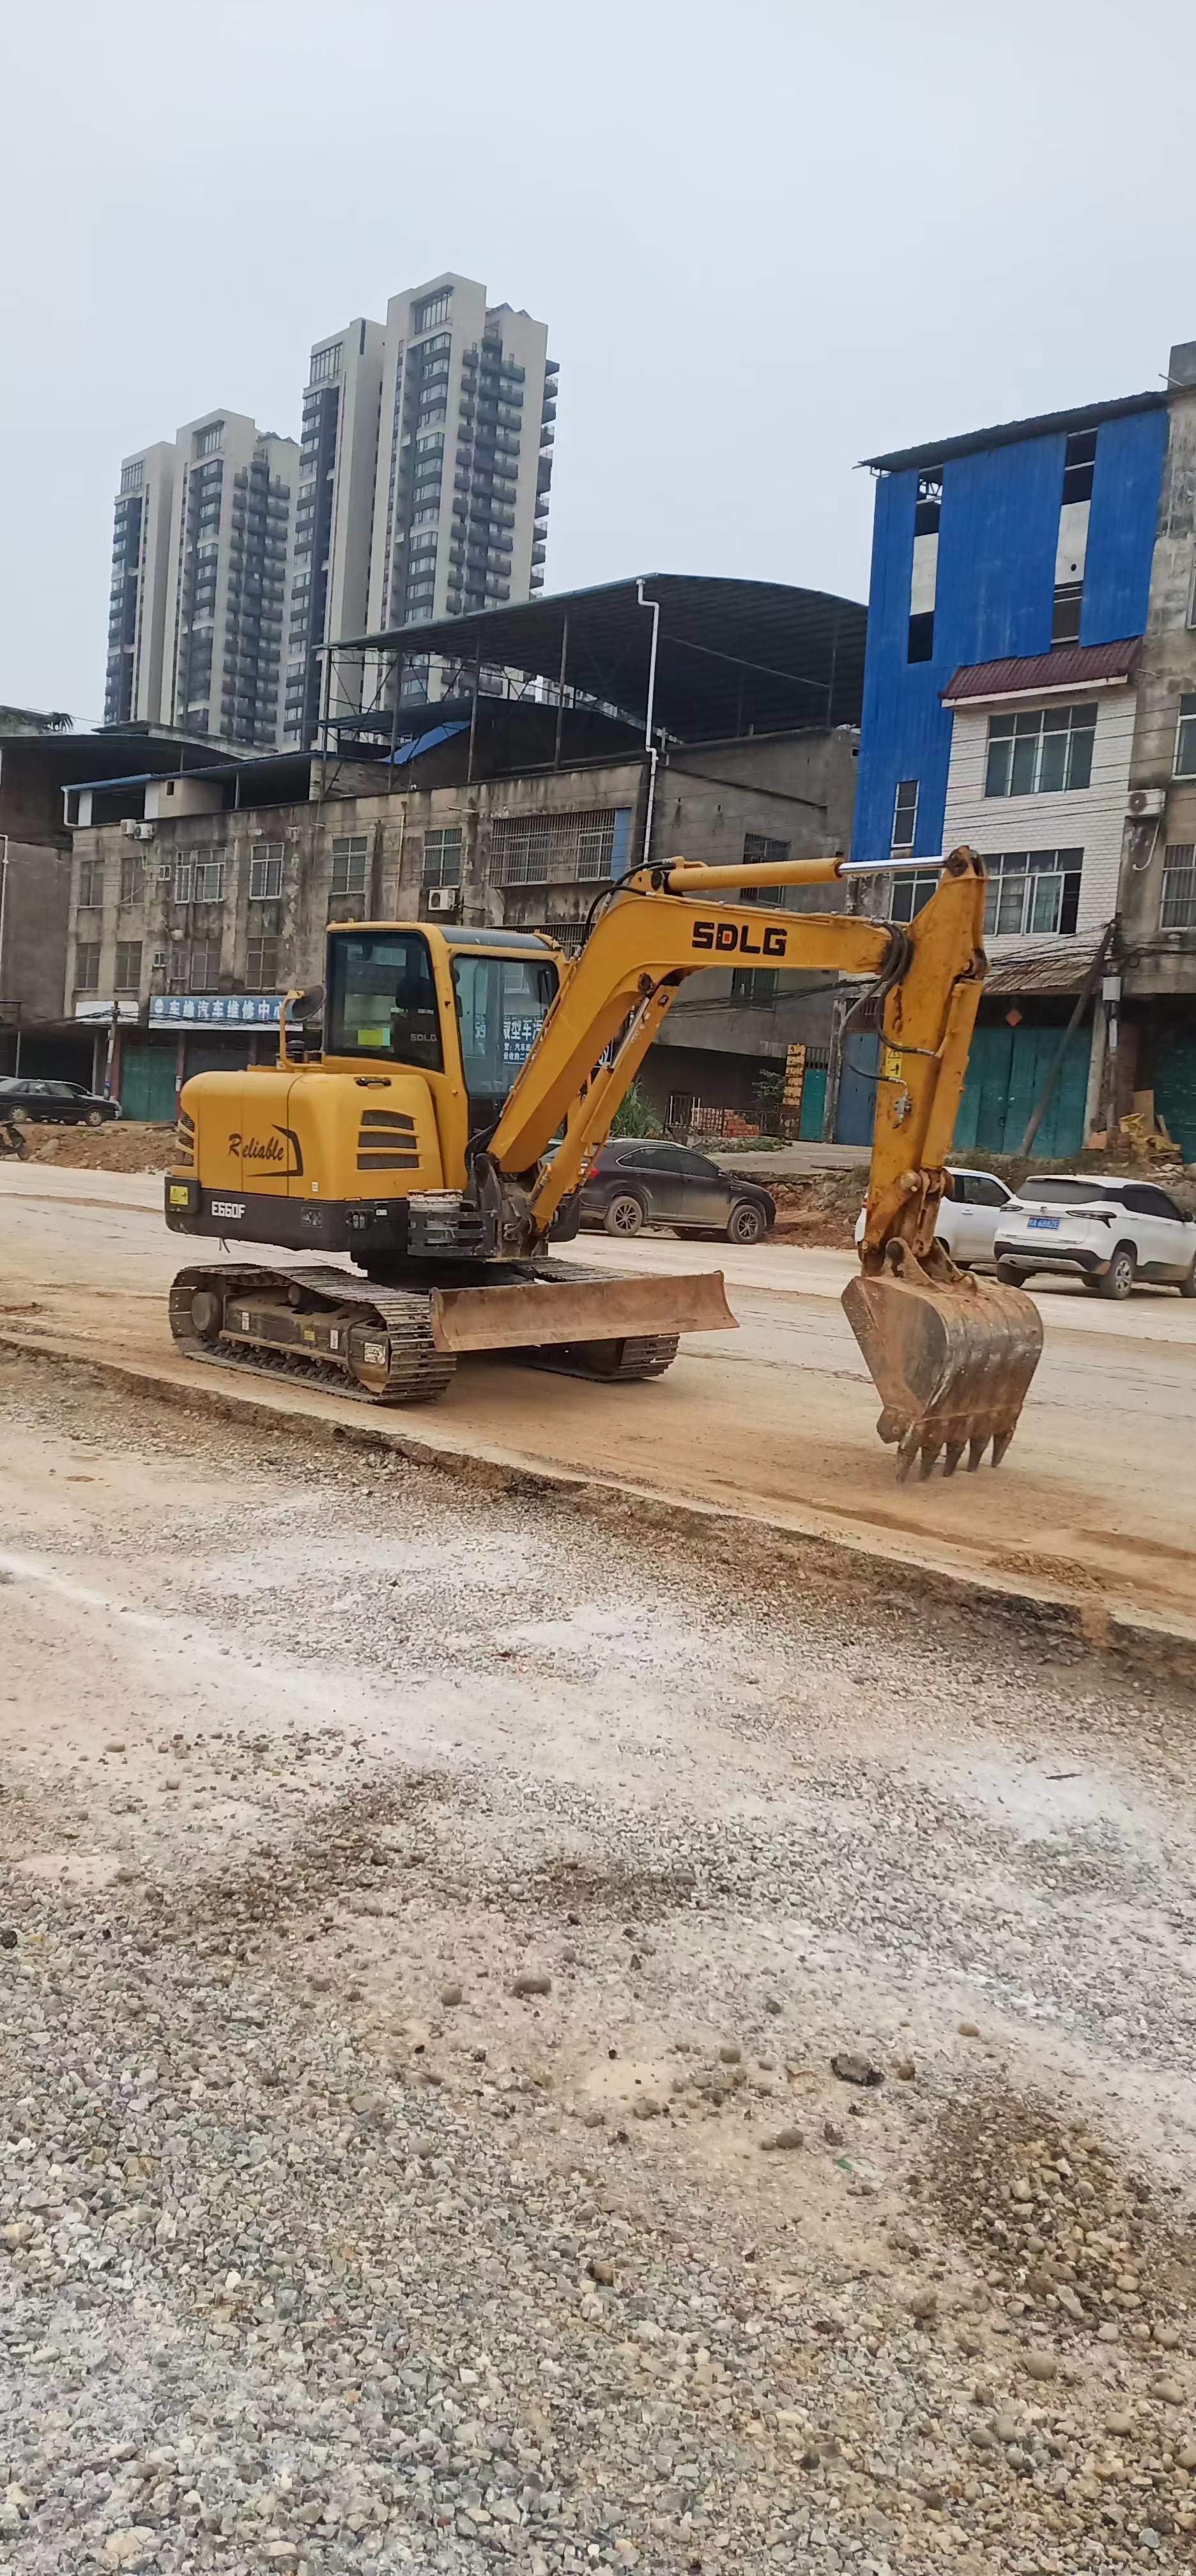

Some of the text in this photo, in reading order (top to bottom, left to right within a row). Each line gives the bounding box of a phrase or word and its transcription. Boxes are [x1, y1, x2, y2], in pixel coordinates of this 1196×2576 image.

[692, 921, 787, 956] SDLG
[410, 1033, 437, 1041] SDLG
[228, 1133, 284, 1162] Reliable
[211, 1201, 246, 1219] E660F
